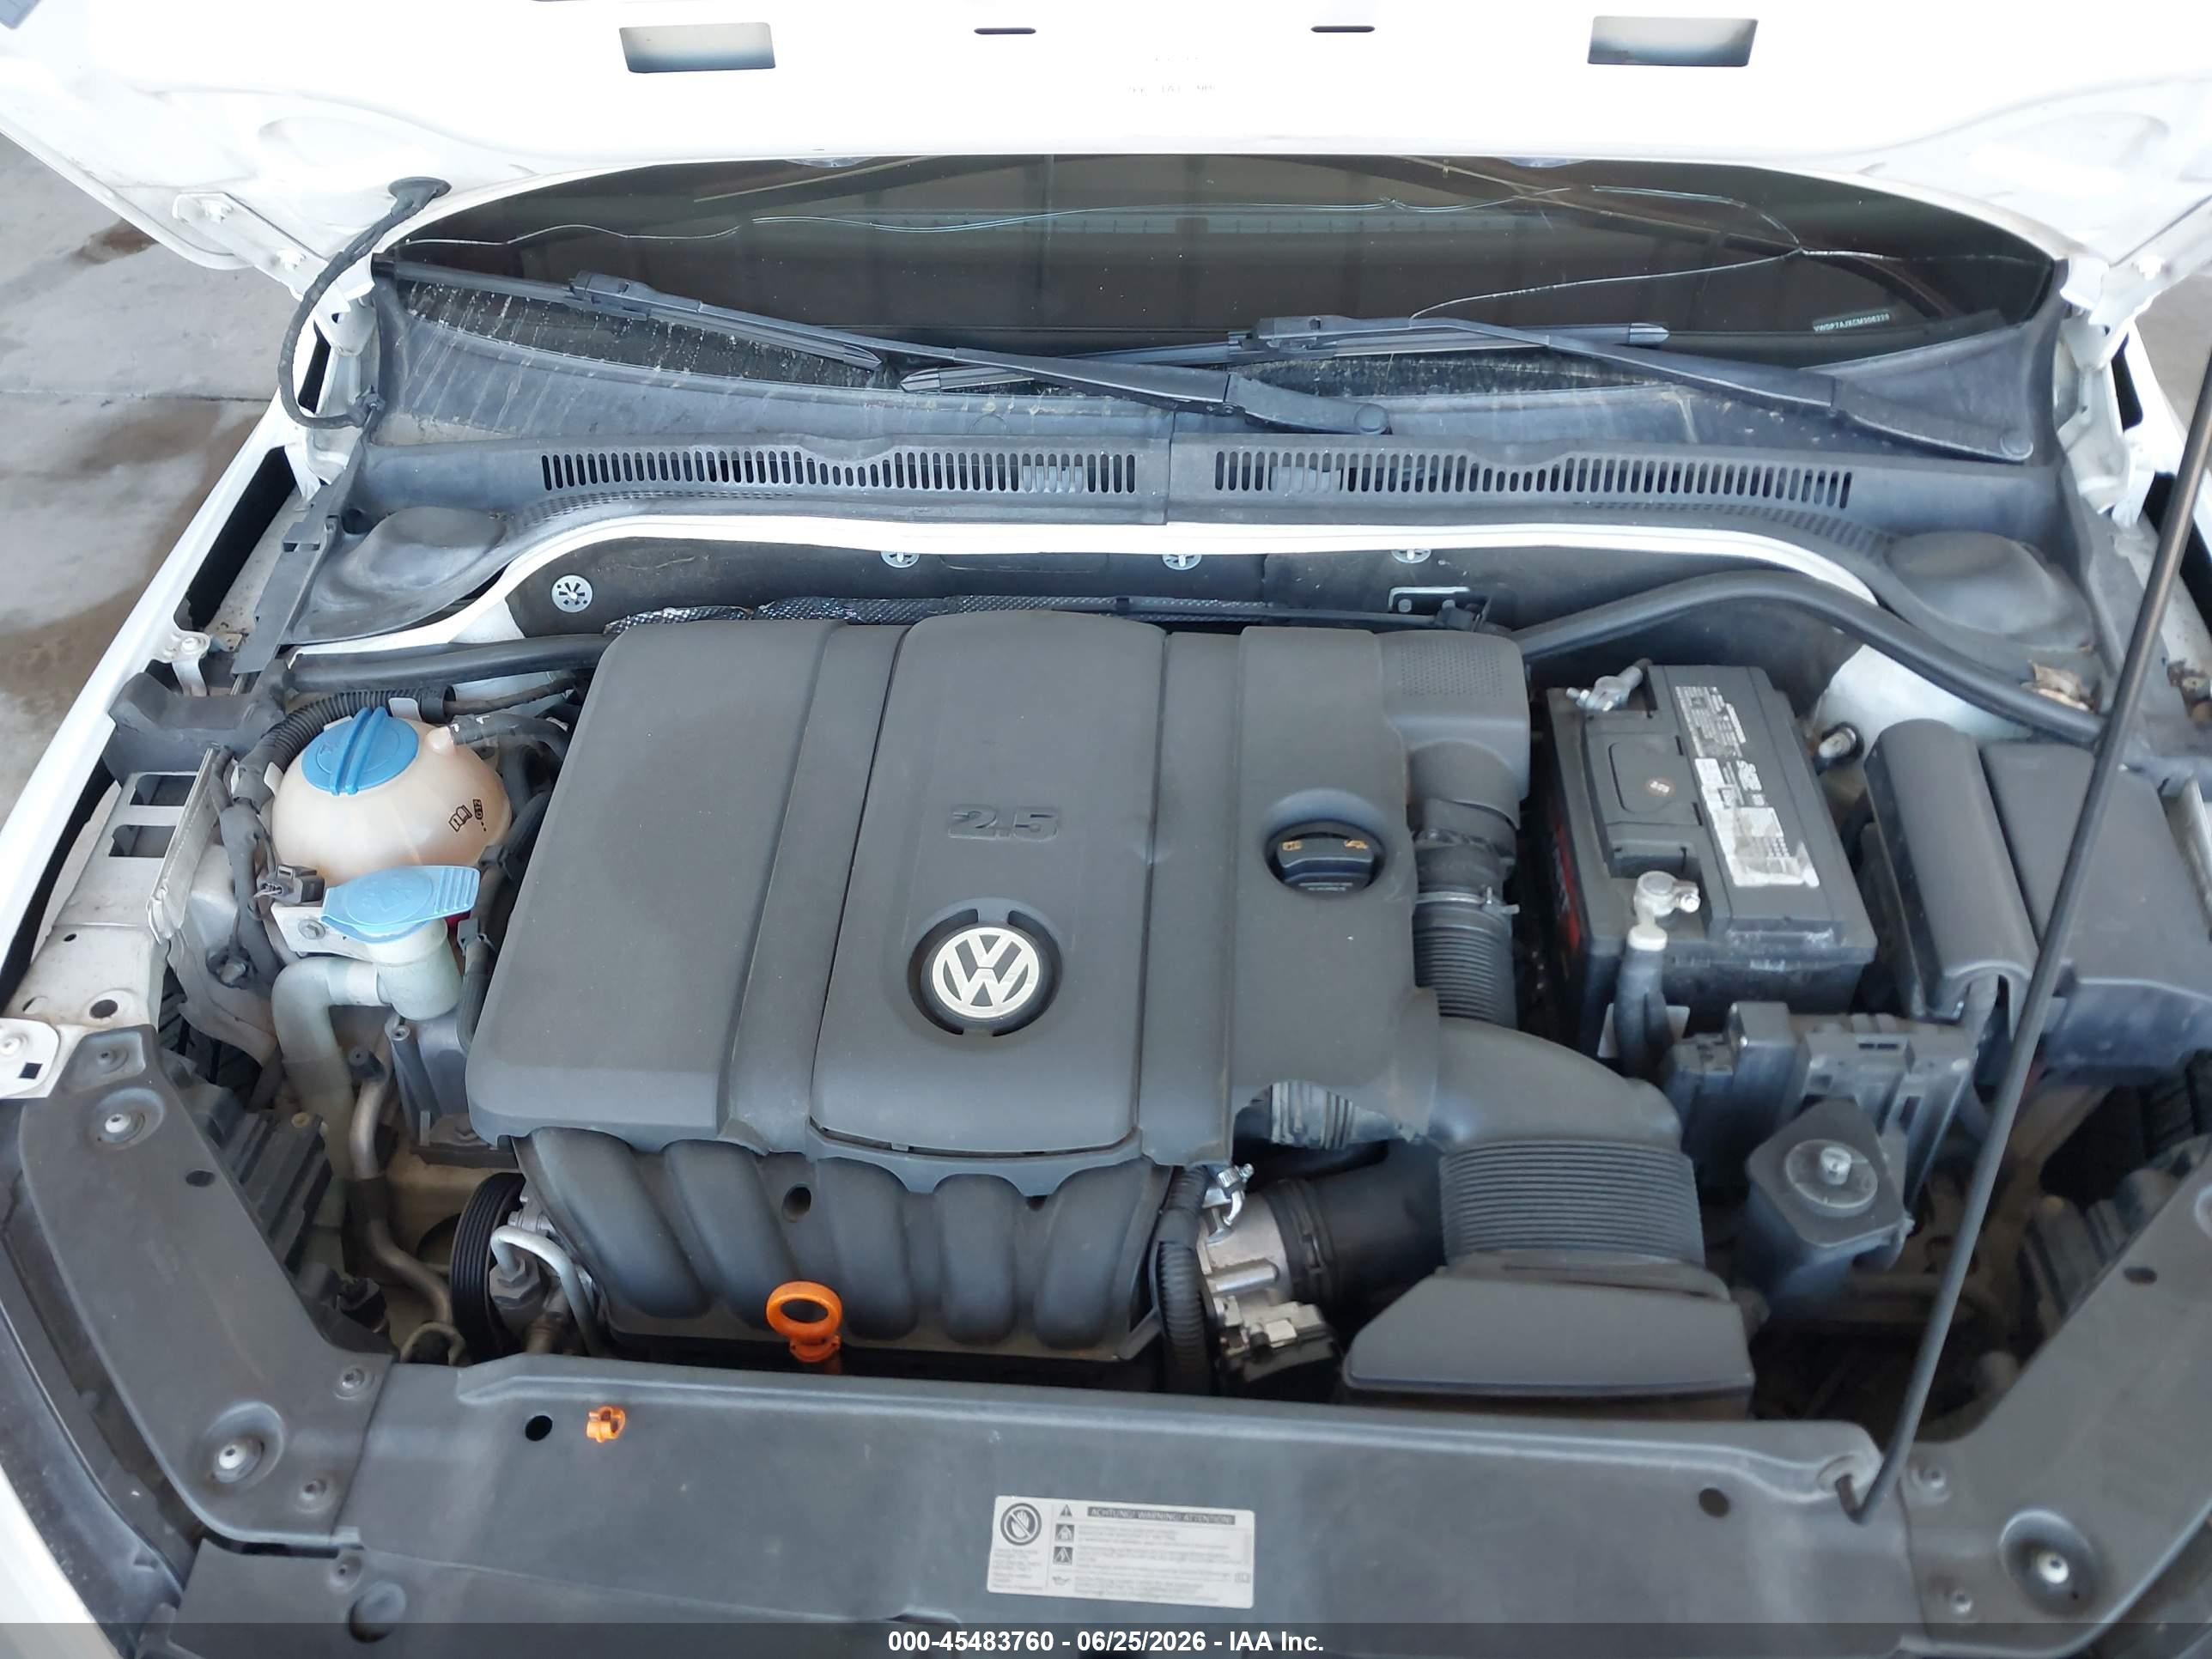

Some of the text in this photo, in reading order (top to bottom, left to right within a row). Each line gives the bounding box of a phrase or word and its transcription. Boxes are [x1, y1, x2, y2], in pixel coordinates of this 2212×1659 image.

[948, 805, 1058, 842] 2.5
[933, 927, 1040, 1018] VW
[1091, 1508, 1134, 1519] ACHTUNG!
[1137, 1510, 1182, 1522] WARNING!
